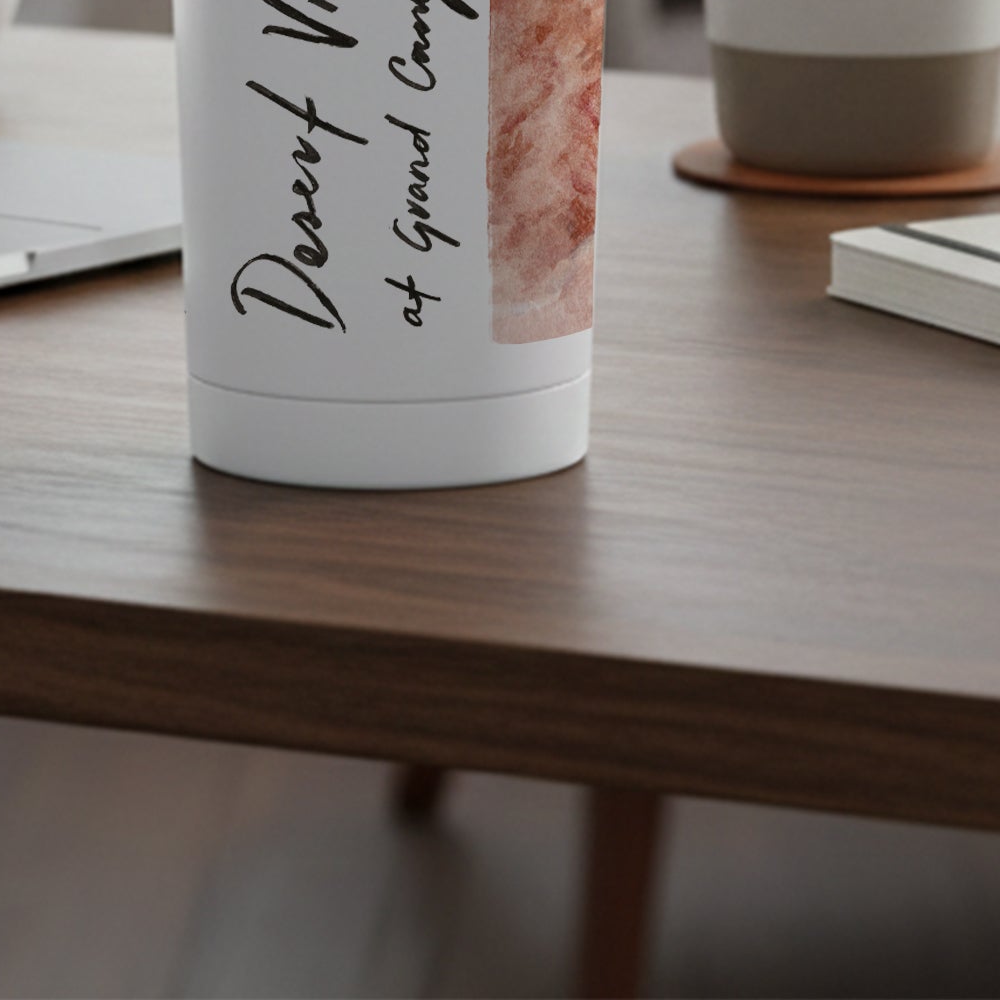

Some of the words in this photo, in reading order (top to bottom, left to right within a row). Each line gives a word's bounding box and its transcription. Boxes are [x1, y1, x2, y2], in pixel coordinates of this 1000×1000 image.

[230, 79, 370, 334] Desert
[384, 113, 461, 253] Grand
[384, 274, 442, 328] at
